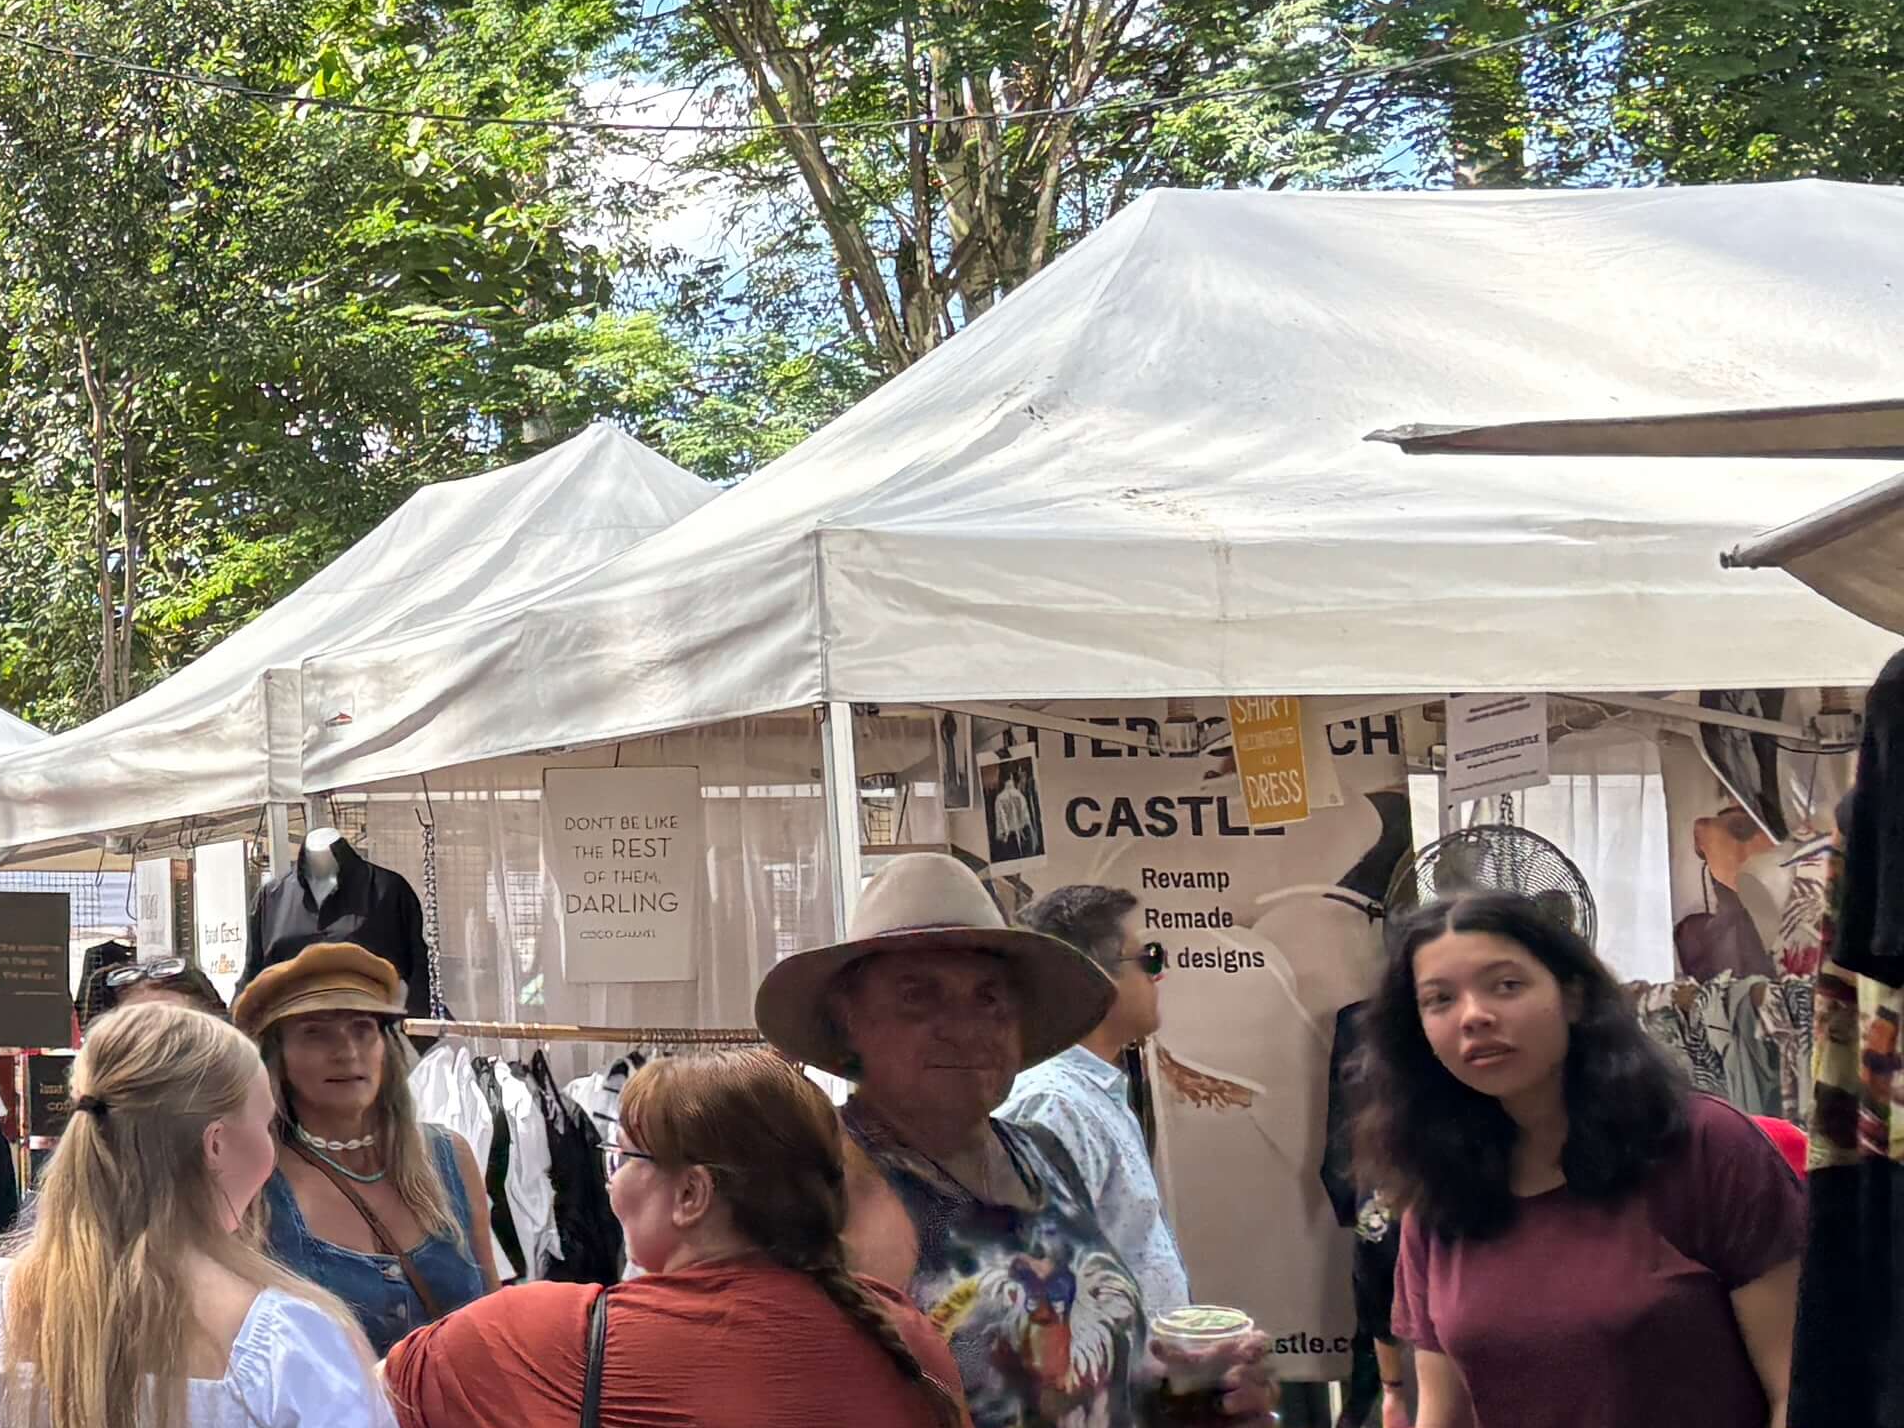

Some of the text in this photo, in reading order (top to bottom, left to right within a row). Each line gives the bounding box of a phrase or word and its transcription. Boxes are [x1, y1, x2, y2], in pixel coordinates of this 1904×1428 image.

[1246, 769, 1303, 809] DRESS
[621, 816, 640, 830] BE
[645, 815, 680, 830] LIKE
[1065, 796, 1286, 838] CASTL
[574, 837, 672, 860] THE REST
[583, 871, 605, 885] OF
[1142, 867, 1230, 893] Revamp
[566, 892, 679, 914] DARLING
[1145, 905, 1234, 930] Remade
[1177, 945, 1265, 974] designs
